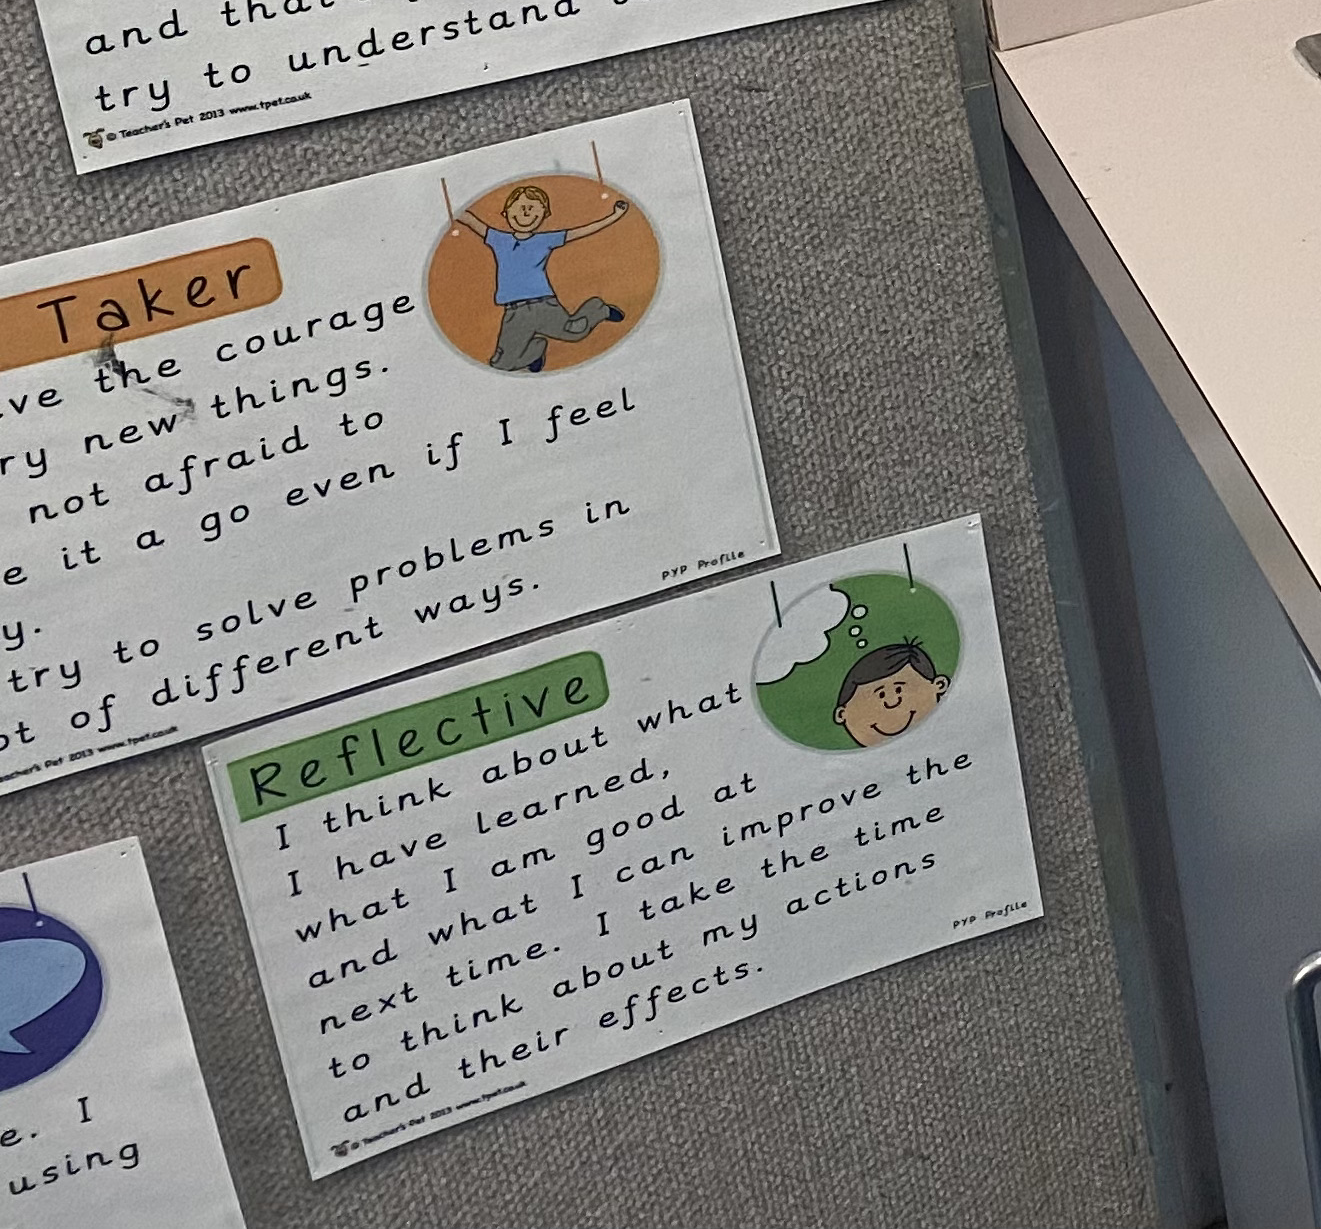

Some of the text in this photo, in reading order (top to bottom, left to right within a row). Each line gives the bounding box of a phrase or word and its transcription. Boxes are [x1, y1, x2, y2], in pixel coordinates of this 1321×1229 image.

[85, 8, 189, 55] and
[119, 92, 311, 140] Teacher's Pet 2013 www.tpet.co.uk
[37, 265, 250, 343] Taker
[93, 295, 416, 396] the courage
[7, 499, 631, 693] try to solve problems in
[697, 550, 745, 569] Profile
[70, 578, 539, 734] of different ways.
[250, 676, 589, 805] Reflective
[275, 682, 743, 851] I think about what
[328, 853, 936, 1079] to think about my actions
[343, 961, 763, 1127] and their effects.
[77, 1096, 93, 1124] I
[8, 1142, 140, 1196] using
